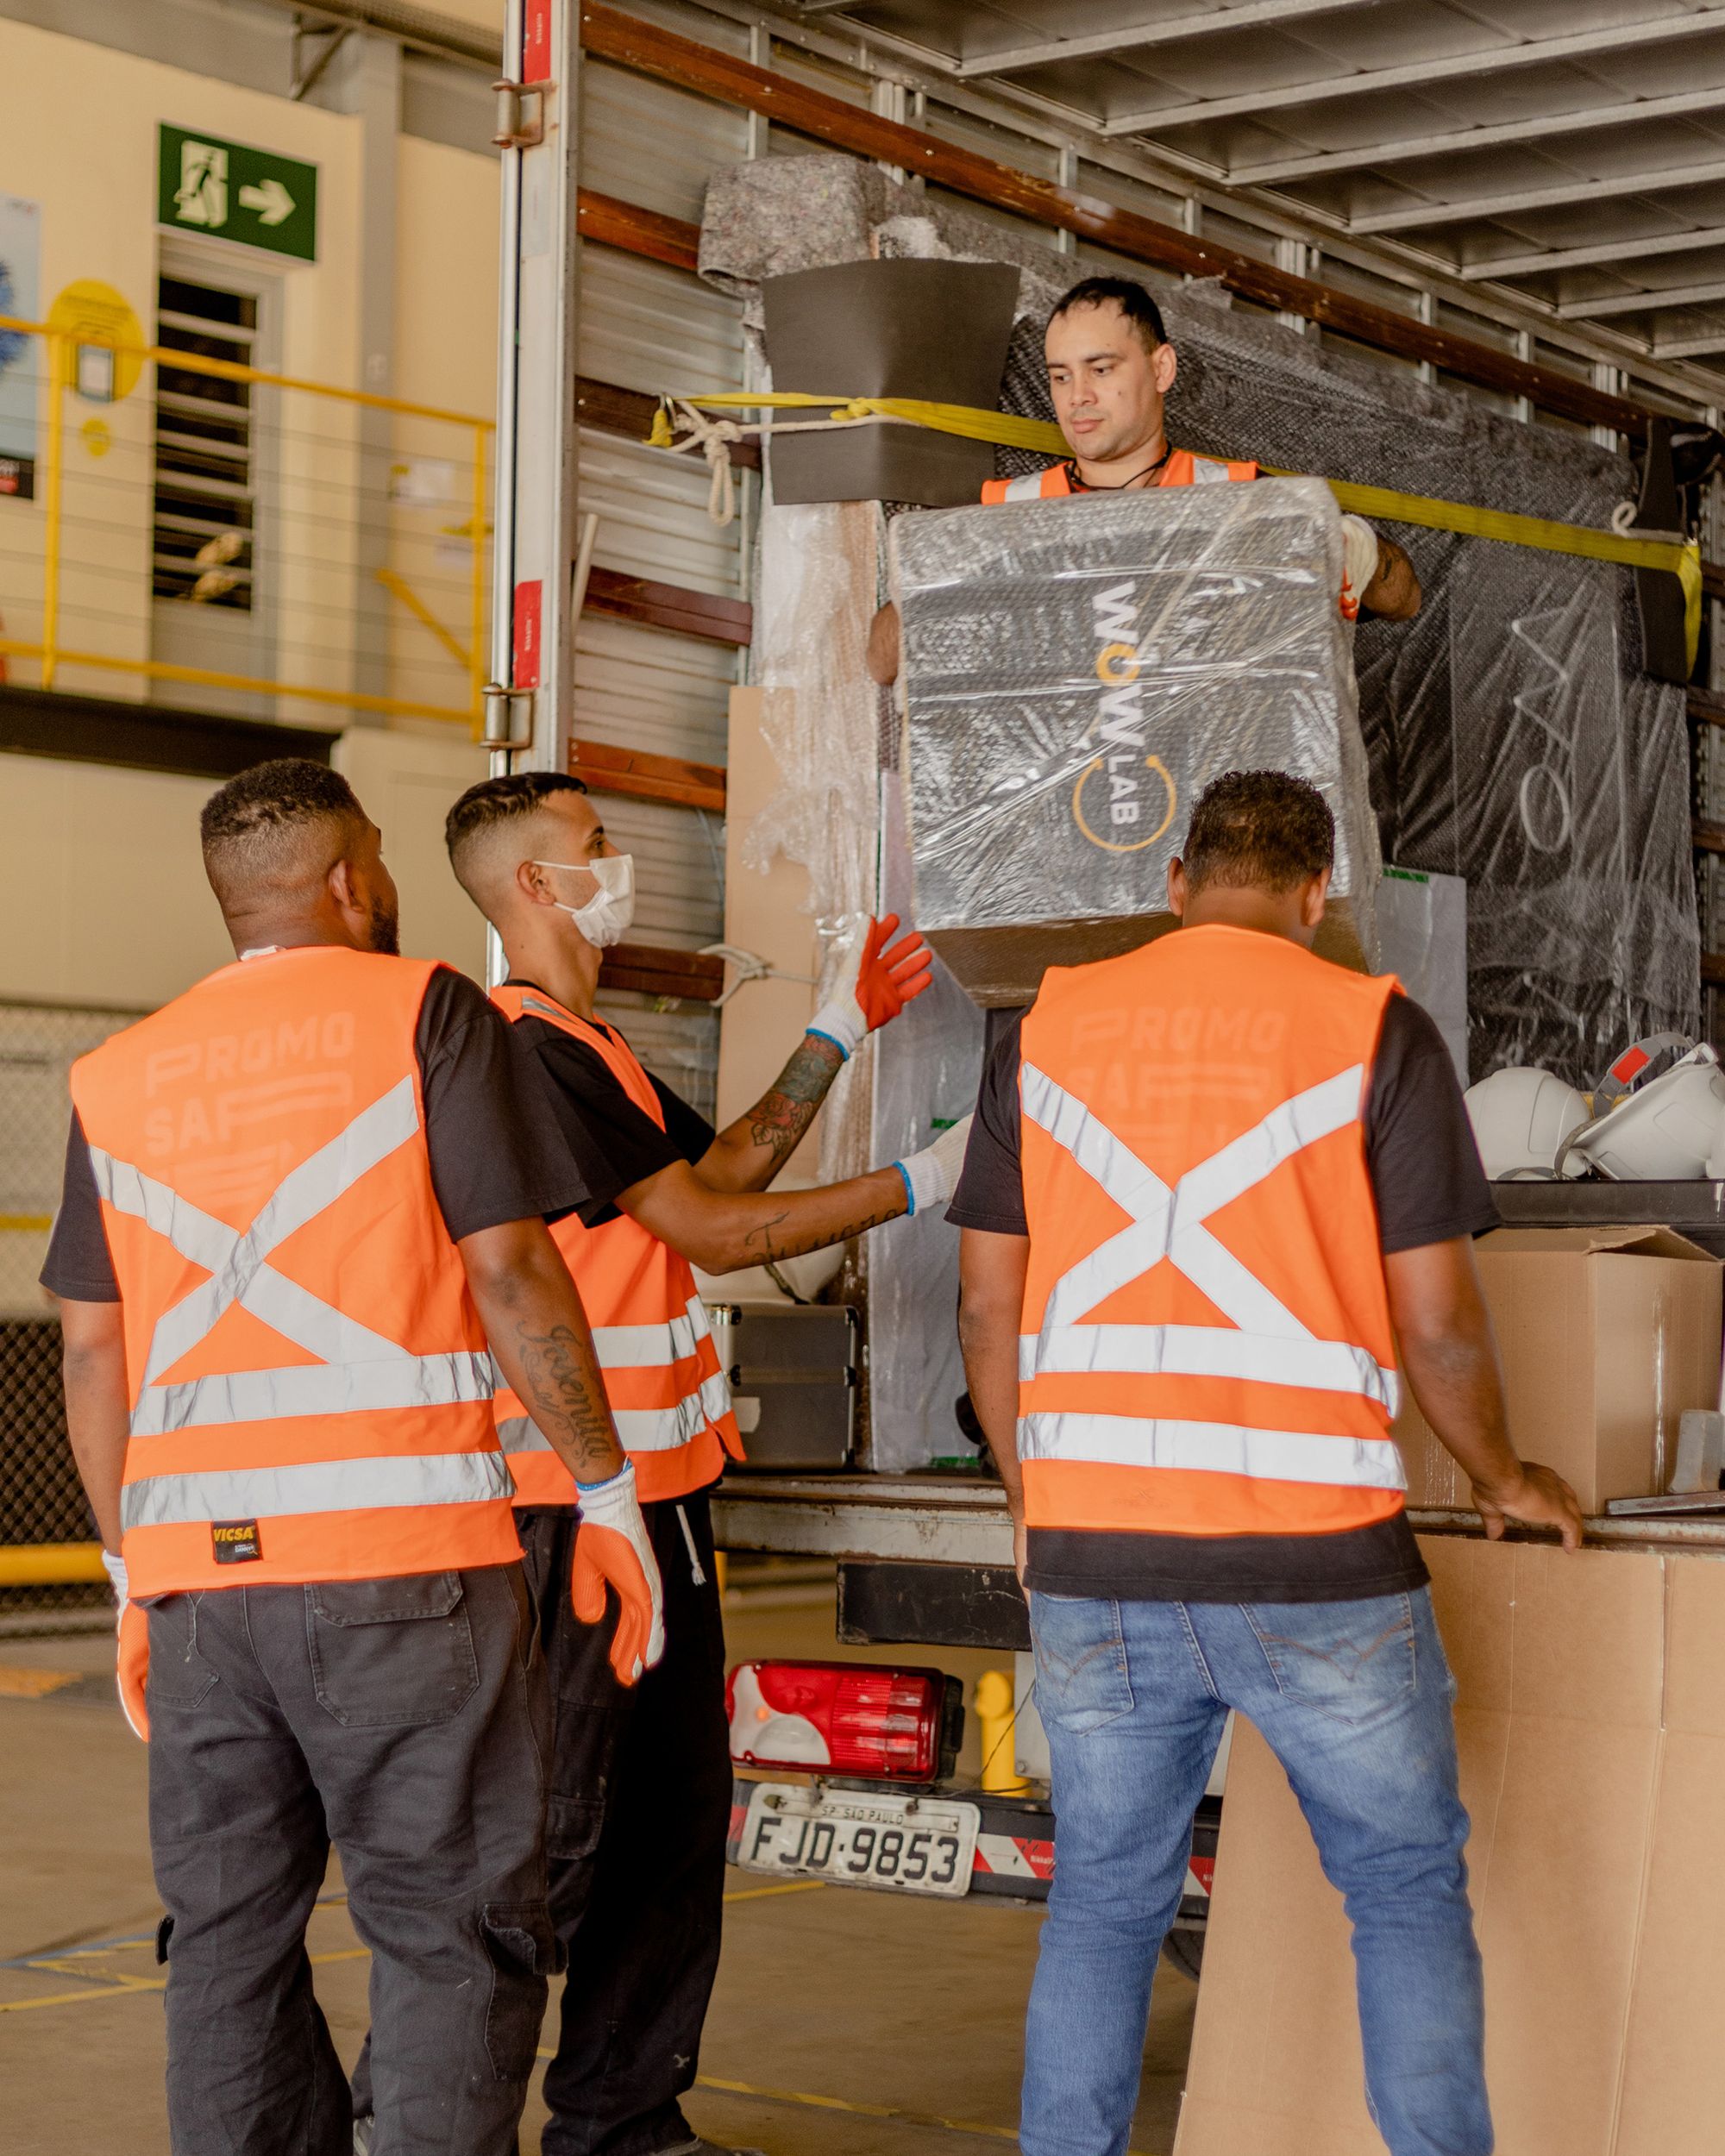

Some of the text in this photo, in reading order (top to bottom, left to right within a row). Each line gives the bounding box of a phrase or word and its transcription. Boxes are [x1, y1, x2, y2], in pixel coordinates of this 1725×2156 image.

[1070, 1006, 1286, 1056] PROMO
[145, 1011, 356, 1099] PROMO
[213, 1526, 254, 1542] VICSA
[869, 1810, 904, 1825] PAULO
